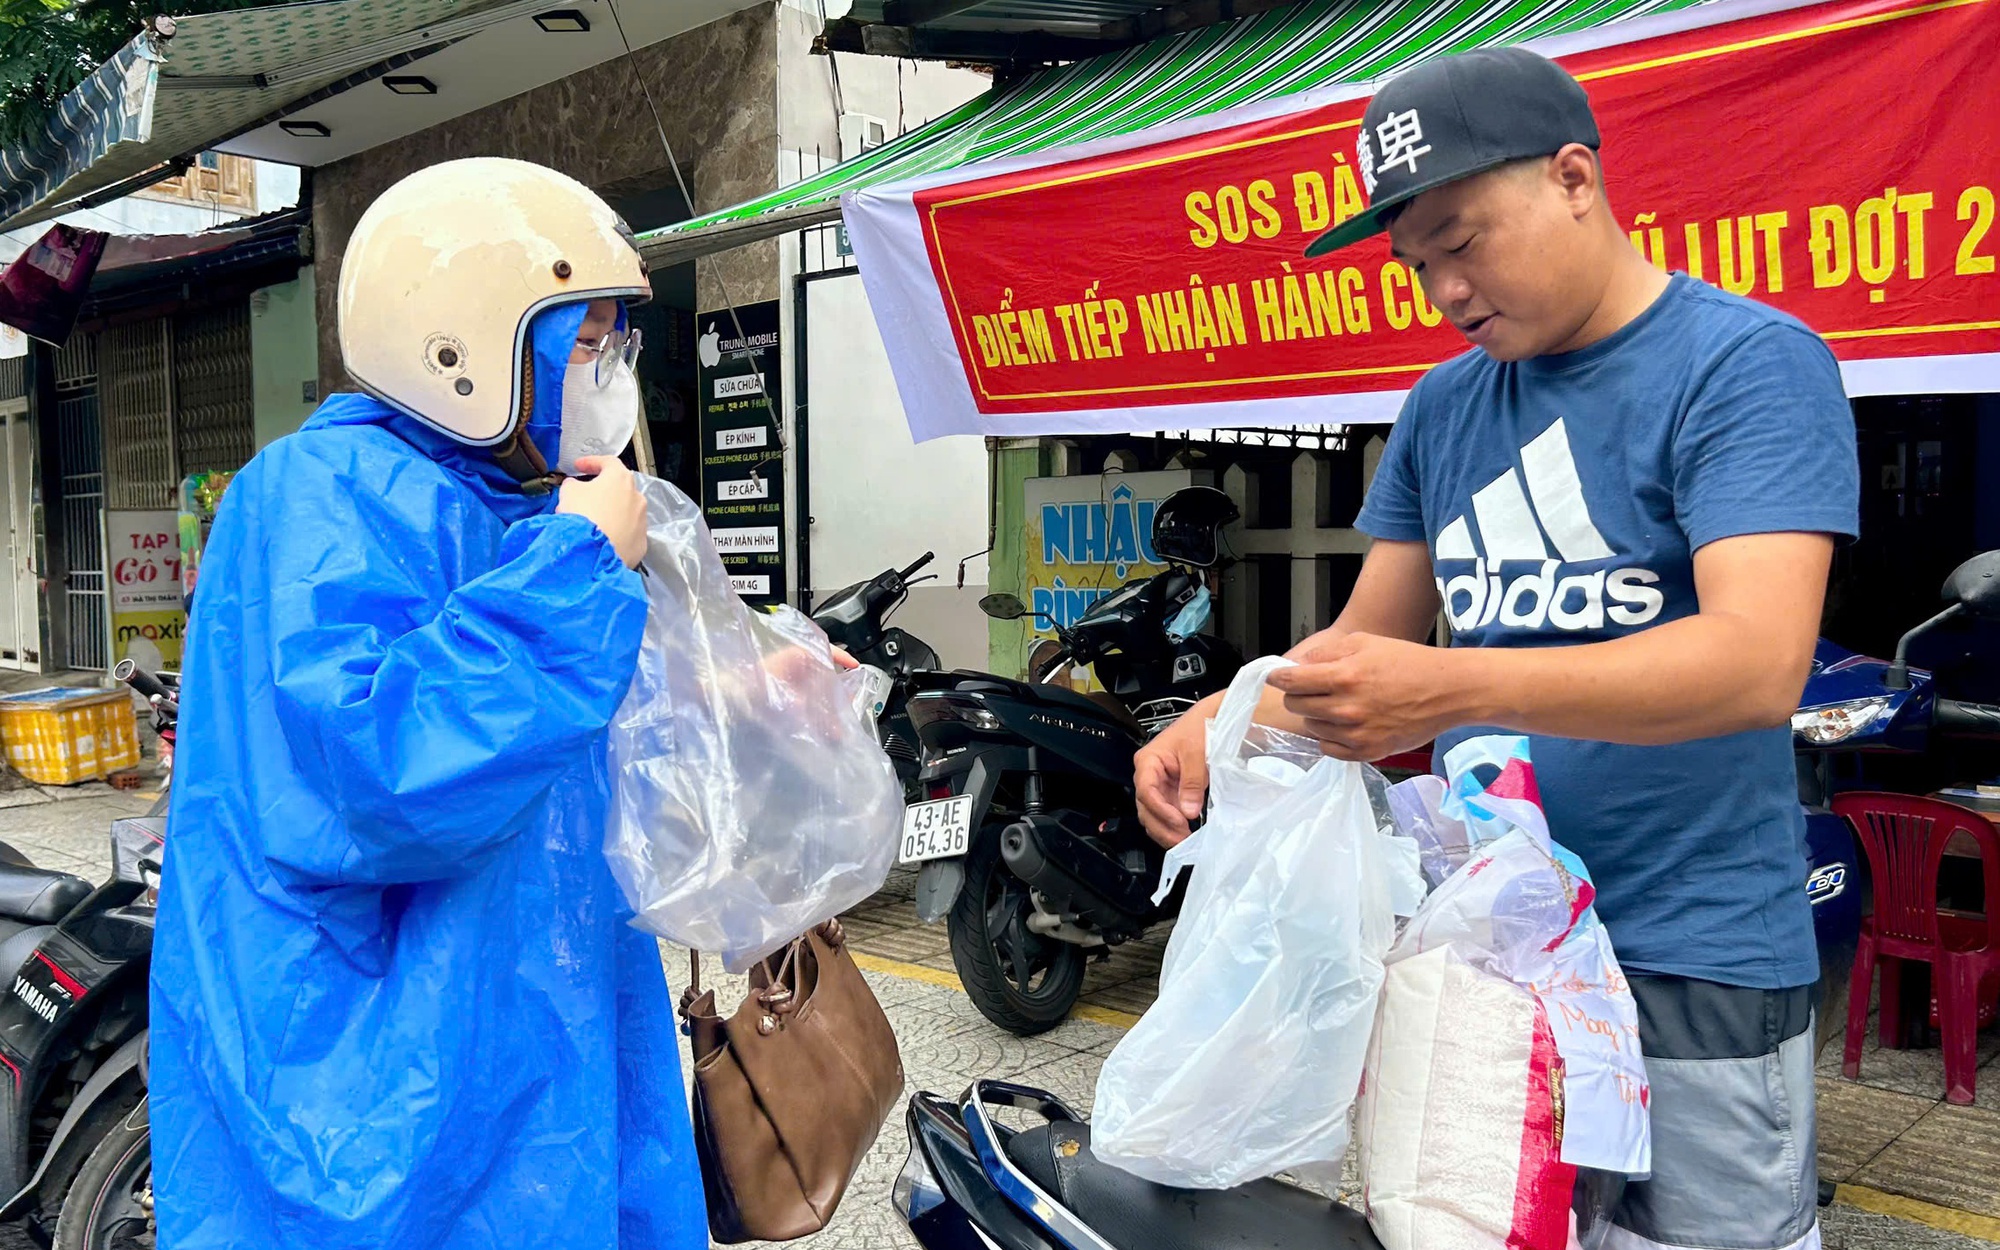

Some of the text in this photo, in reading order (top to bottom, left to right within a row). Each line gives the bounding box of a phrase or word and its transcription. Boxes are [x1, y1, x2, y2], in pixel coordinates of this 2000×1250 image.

[1185, 179, 1282, 248] SOS
[972, 288, 1057, 368] ĐIỂM
[1057, 281, 1129, 361] TIẾP
[1138, 274, 1246, 362] NHẬN
[1252, 262, 1371, 342] HÀNG
[1808, 187, 1933, 303] ĐỢT
[1955, 186, 1996, 276] 2
[747, 332, 778, 346] MOBILE
[737, 431, 756, 444] KÍNH
[129, 533, 168, 553] TẠP
[713, 536, 733, 547] THAY
[754, 533, 774, 546] HÌNH
[732, 580, 758, 590] SIM 4G
[914, 801, 962, 831] 43-AE
[905, 826, 964, 858] 054.36
[13, 974, 59, 1023] YAMAHA
